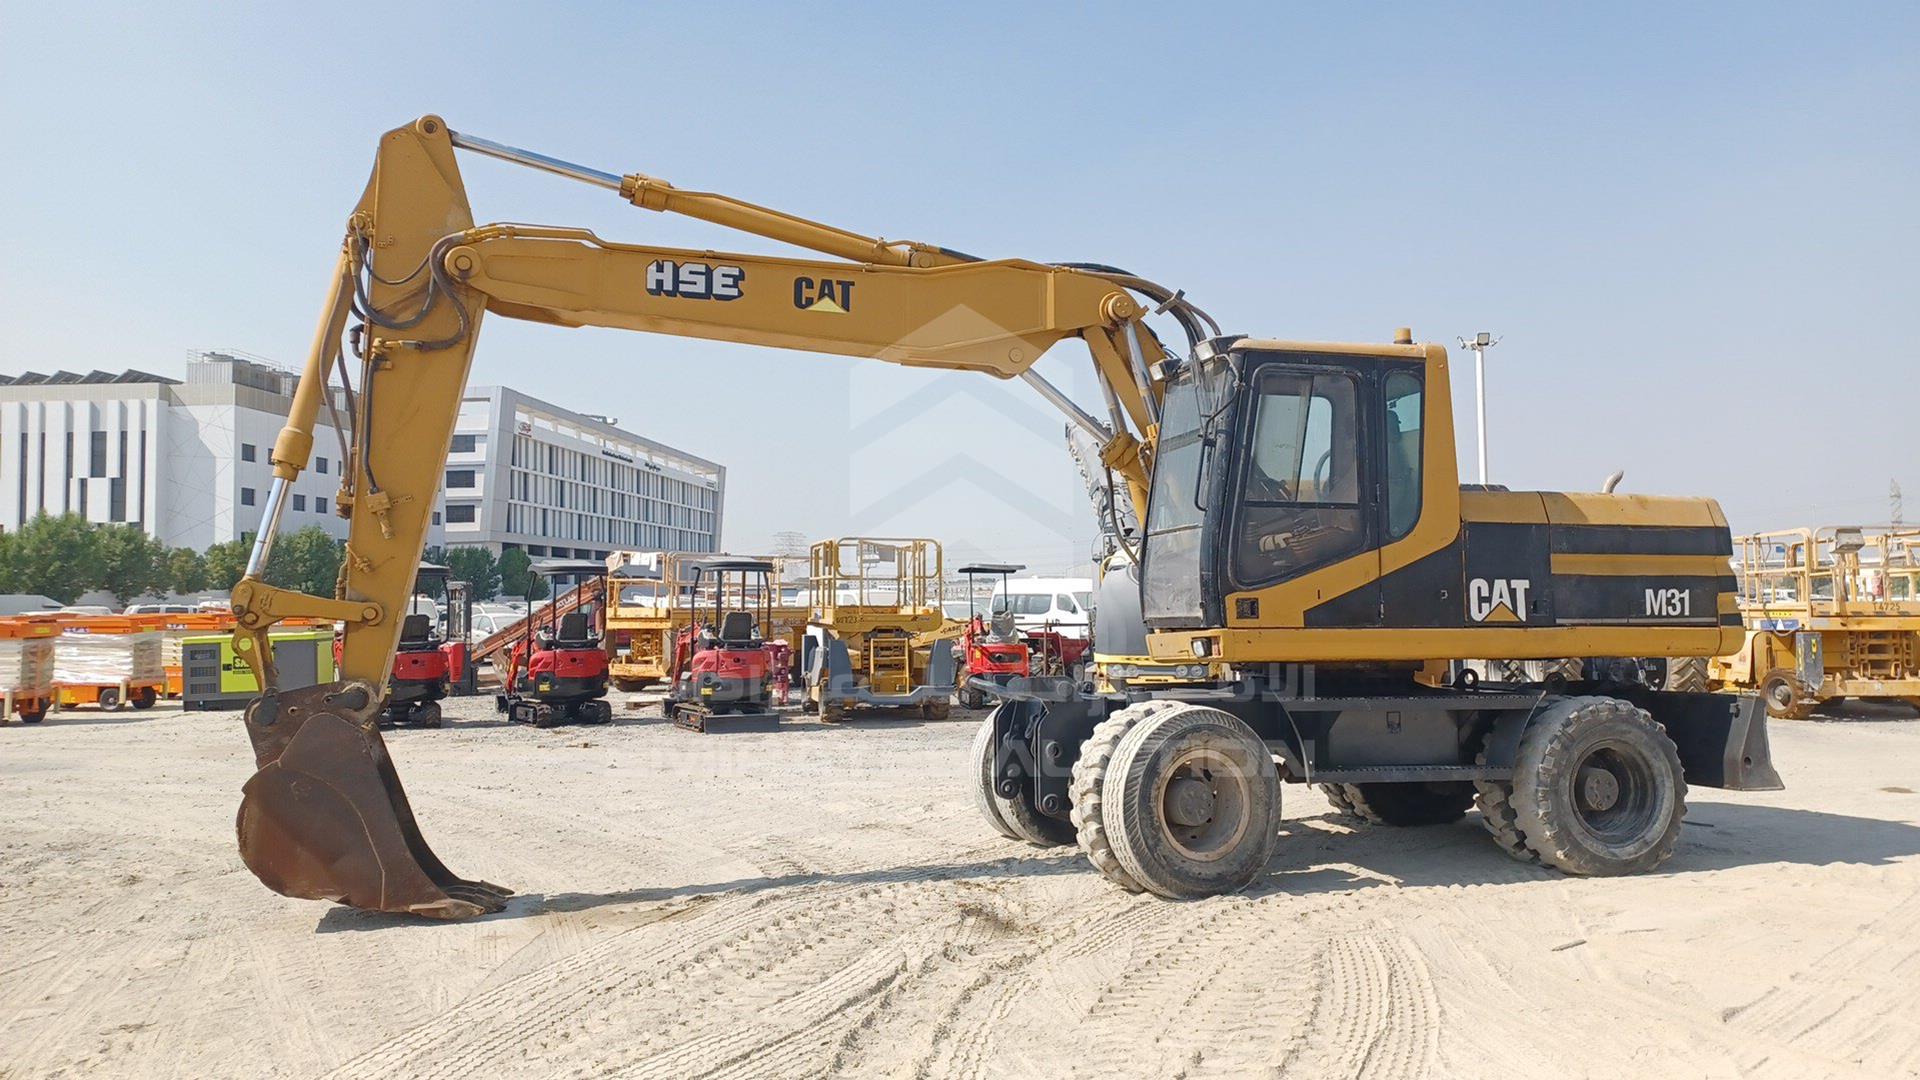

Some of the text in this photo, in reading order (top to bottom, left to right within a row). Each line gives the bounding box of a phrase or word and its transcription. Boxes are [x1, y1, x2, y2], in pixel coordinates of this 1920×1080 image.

[646, 259, 745, 301] HSE
[794, 276, 855, 313] CAT
[1469, 578, 1530, 622] CAT
[1645, 588, 1690, 616] M31
